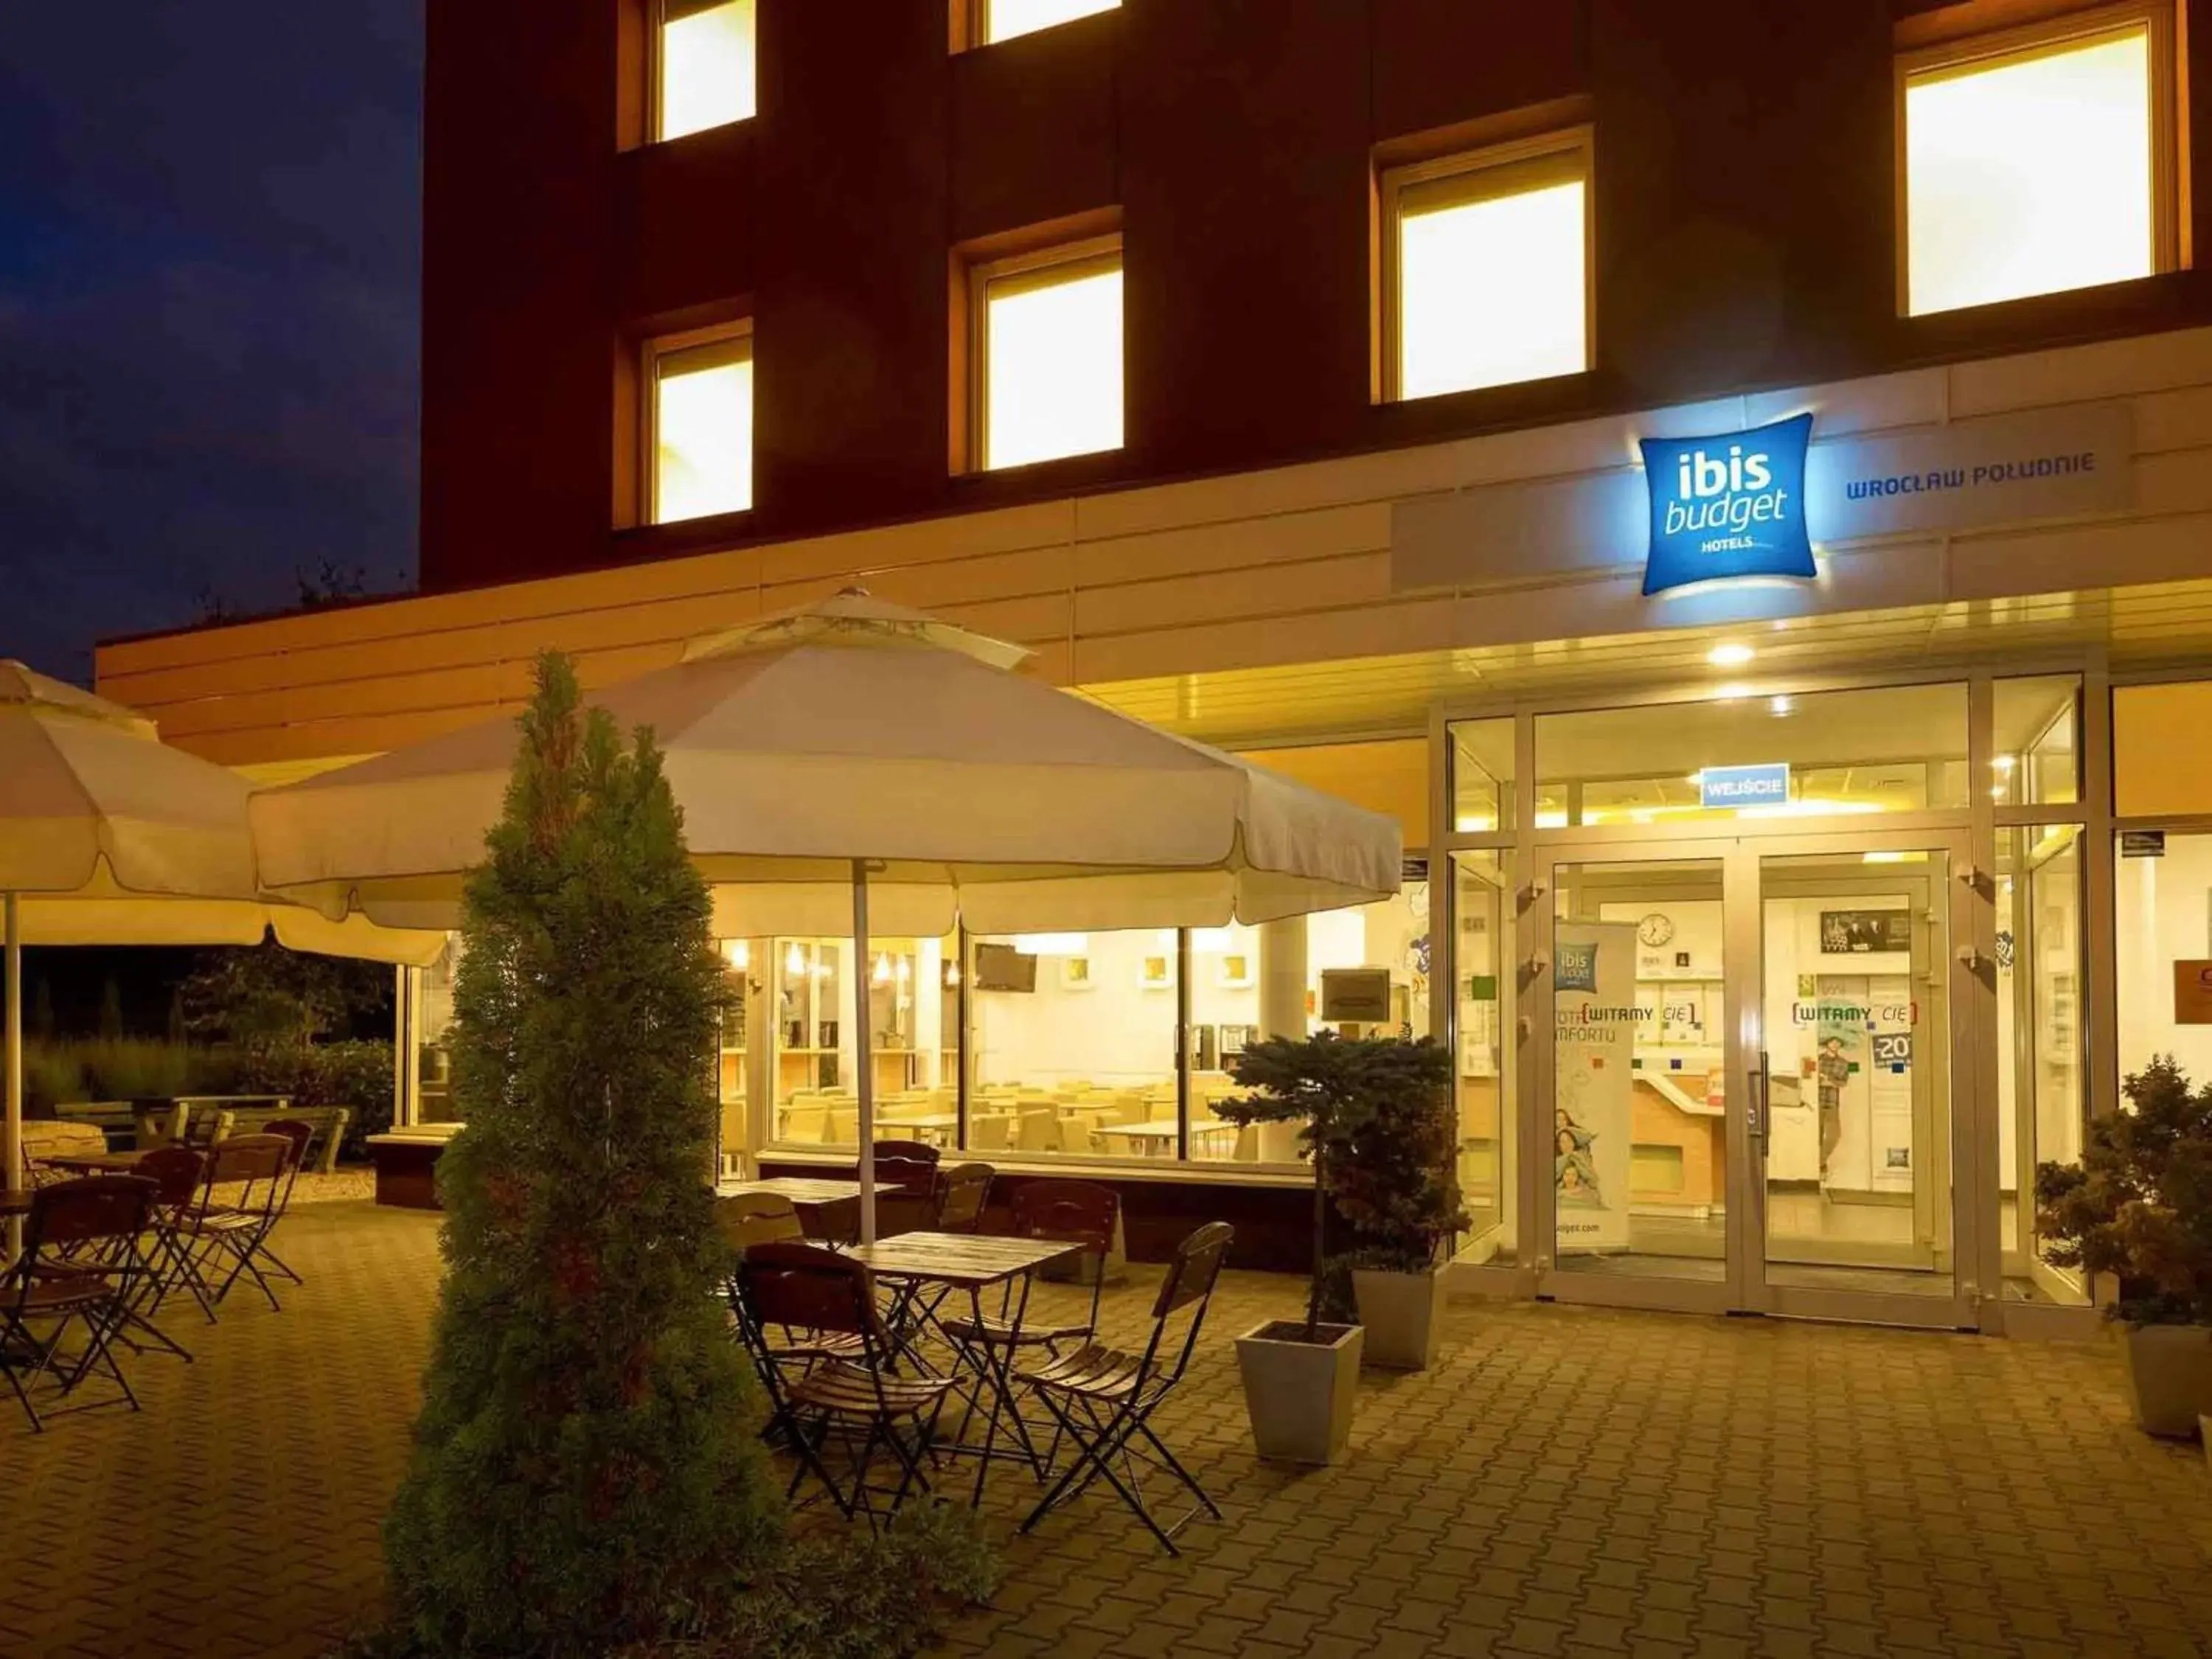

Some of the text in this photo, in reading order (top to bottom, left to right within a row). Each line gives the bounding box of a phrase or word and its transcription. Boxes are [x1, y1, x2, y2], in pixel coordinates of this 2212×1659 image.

[1679, 445, 1772, 501] ibis
[1972, 452, 2095, 486] POŁUDNIE
[1665, 489, 1788, 535] budget
[1701, 535, 1753, 554] HOTELS
[1708, 778, 1783, 797] WEJŚCIE
